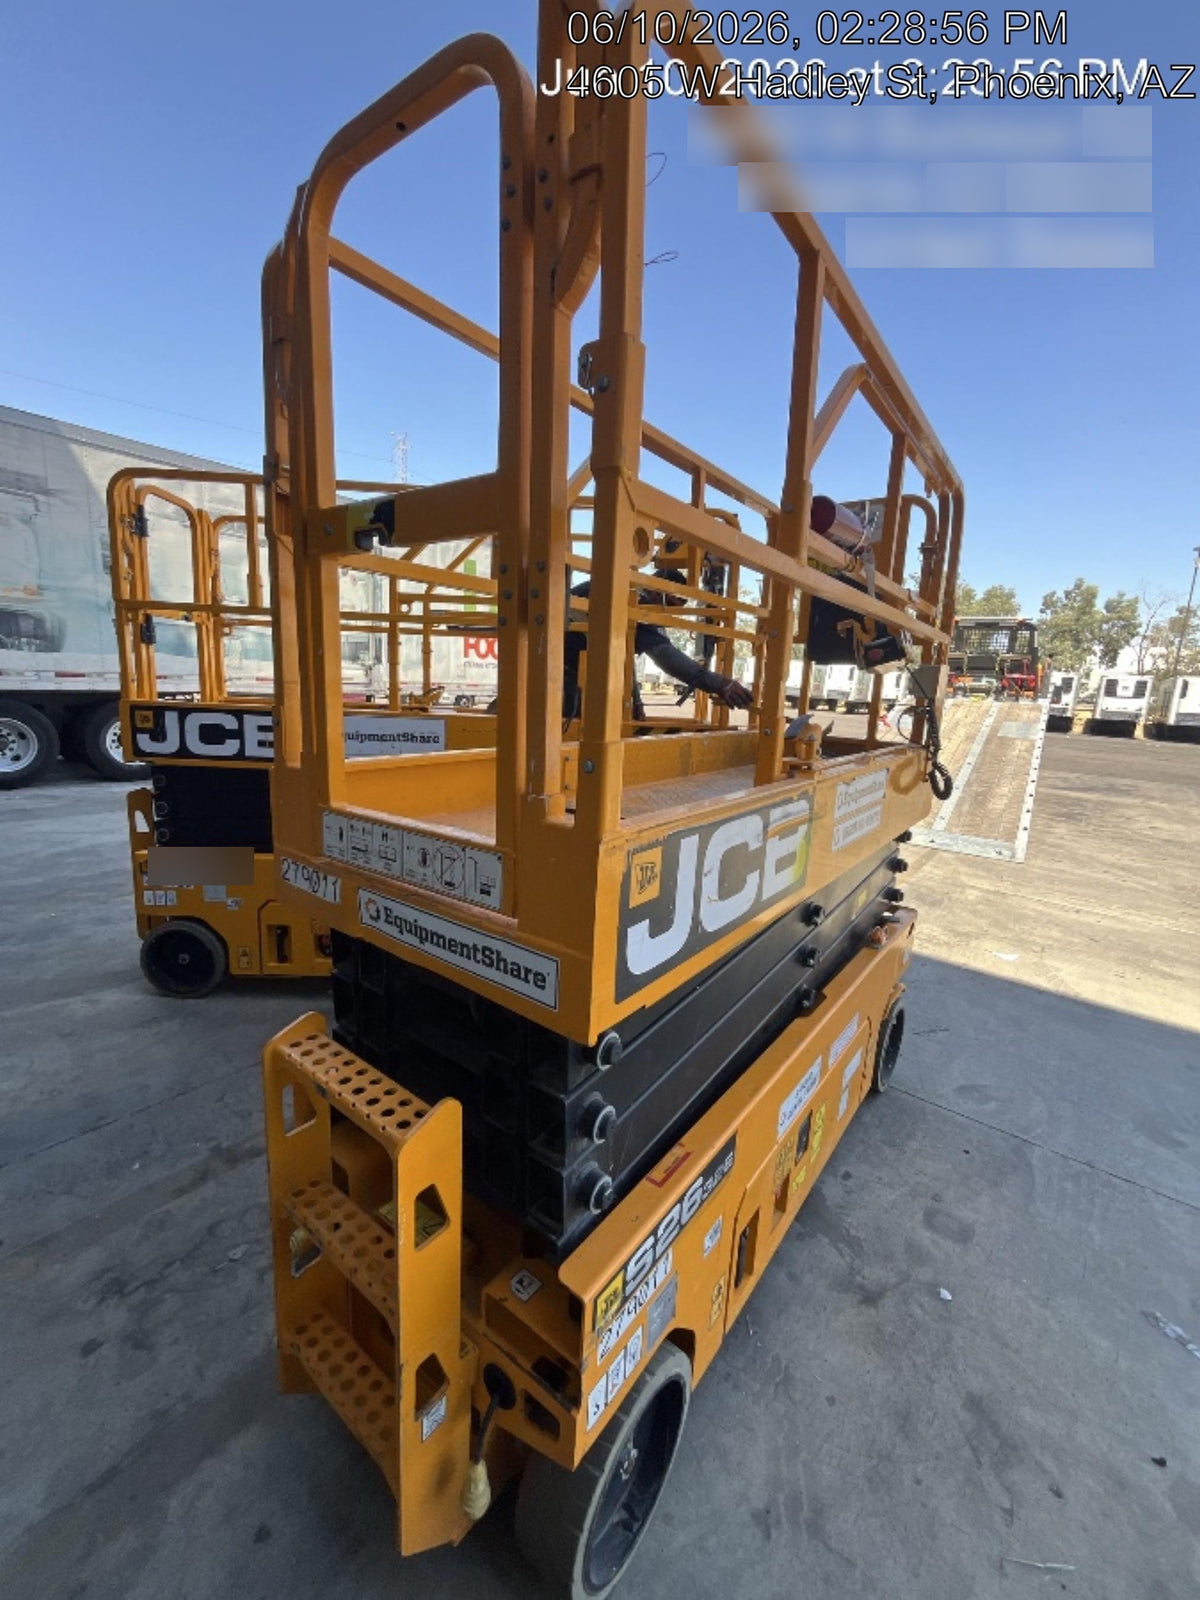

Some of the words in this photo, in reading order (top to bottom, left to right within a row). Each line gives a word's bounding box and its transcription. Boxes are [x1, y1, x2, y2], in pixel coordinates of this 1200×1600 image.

[345, 731, 441, 745] uipmentShare
[282, 858, 338, 902] 279011
[625, 799, 811, 976] JCB
[383, 906, 547, 991] EquipmentShare
